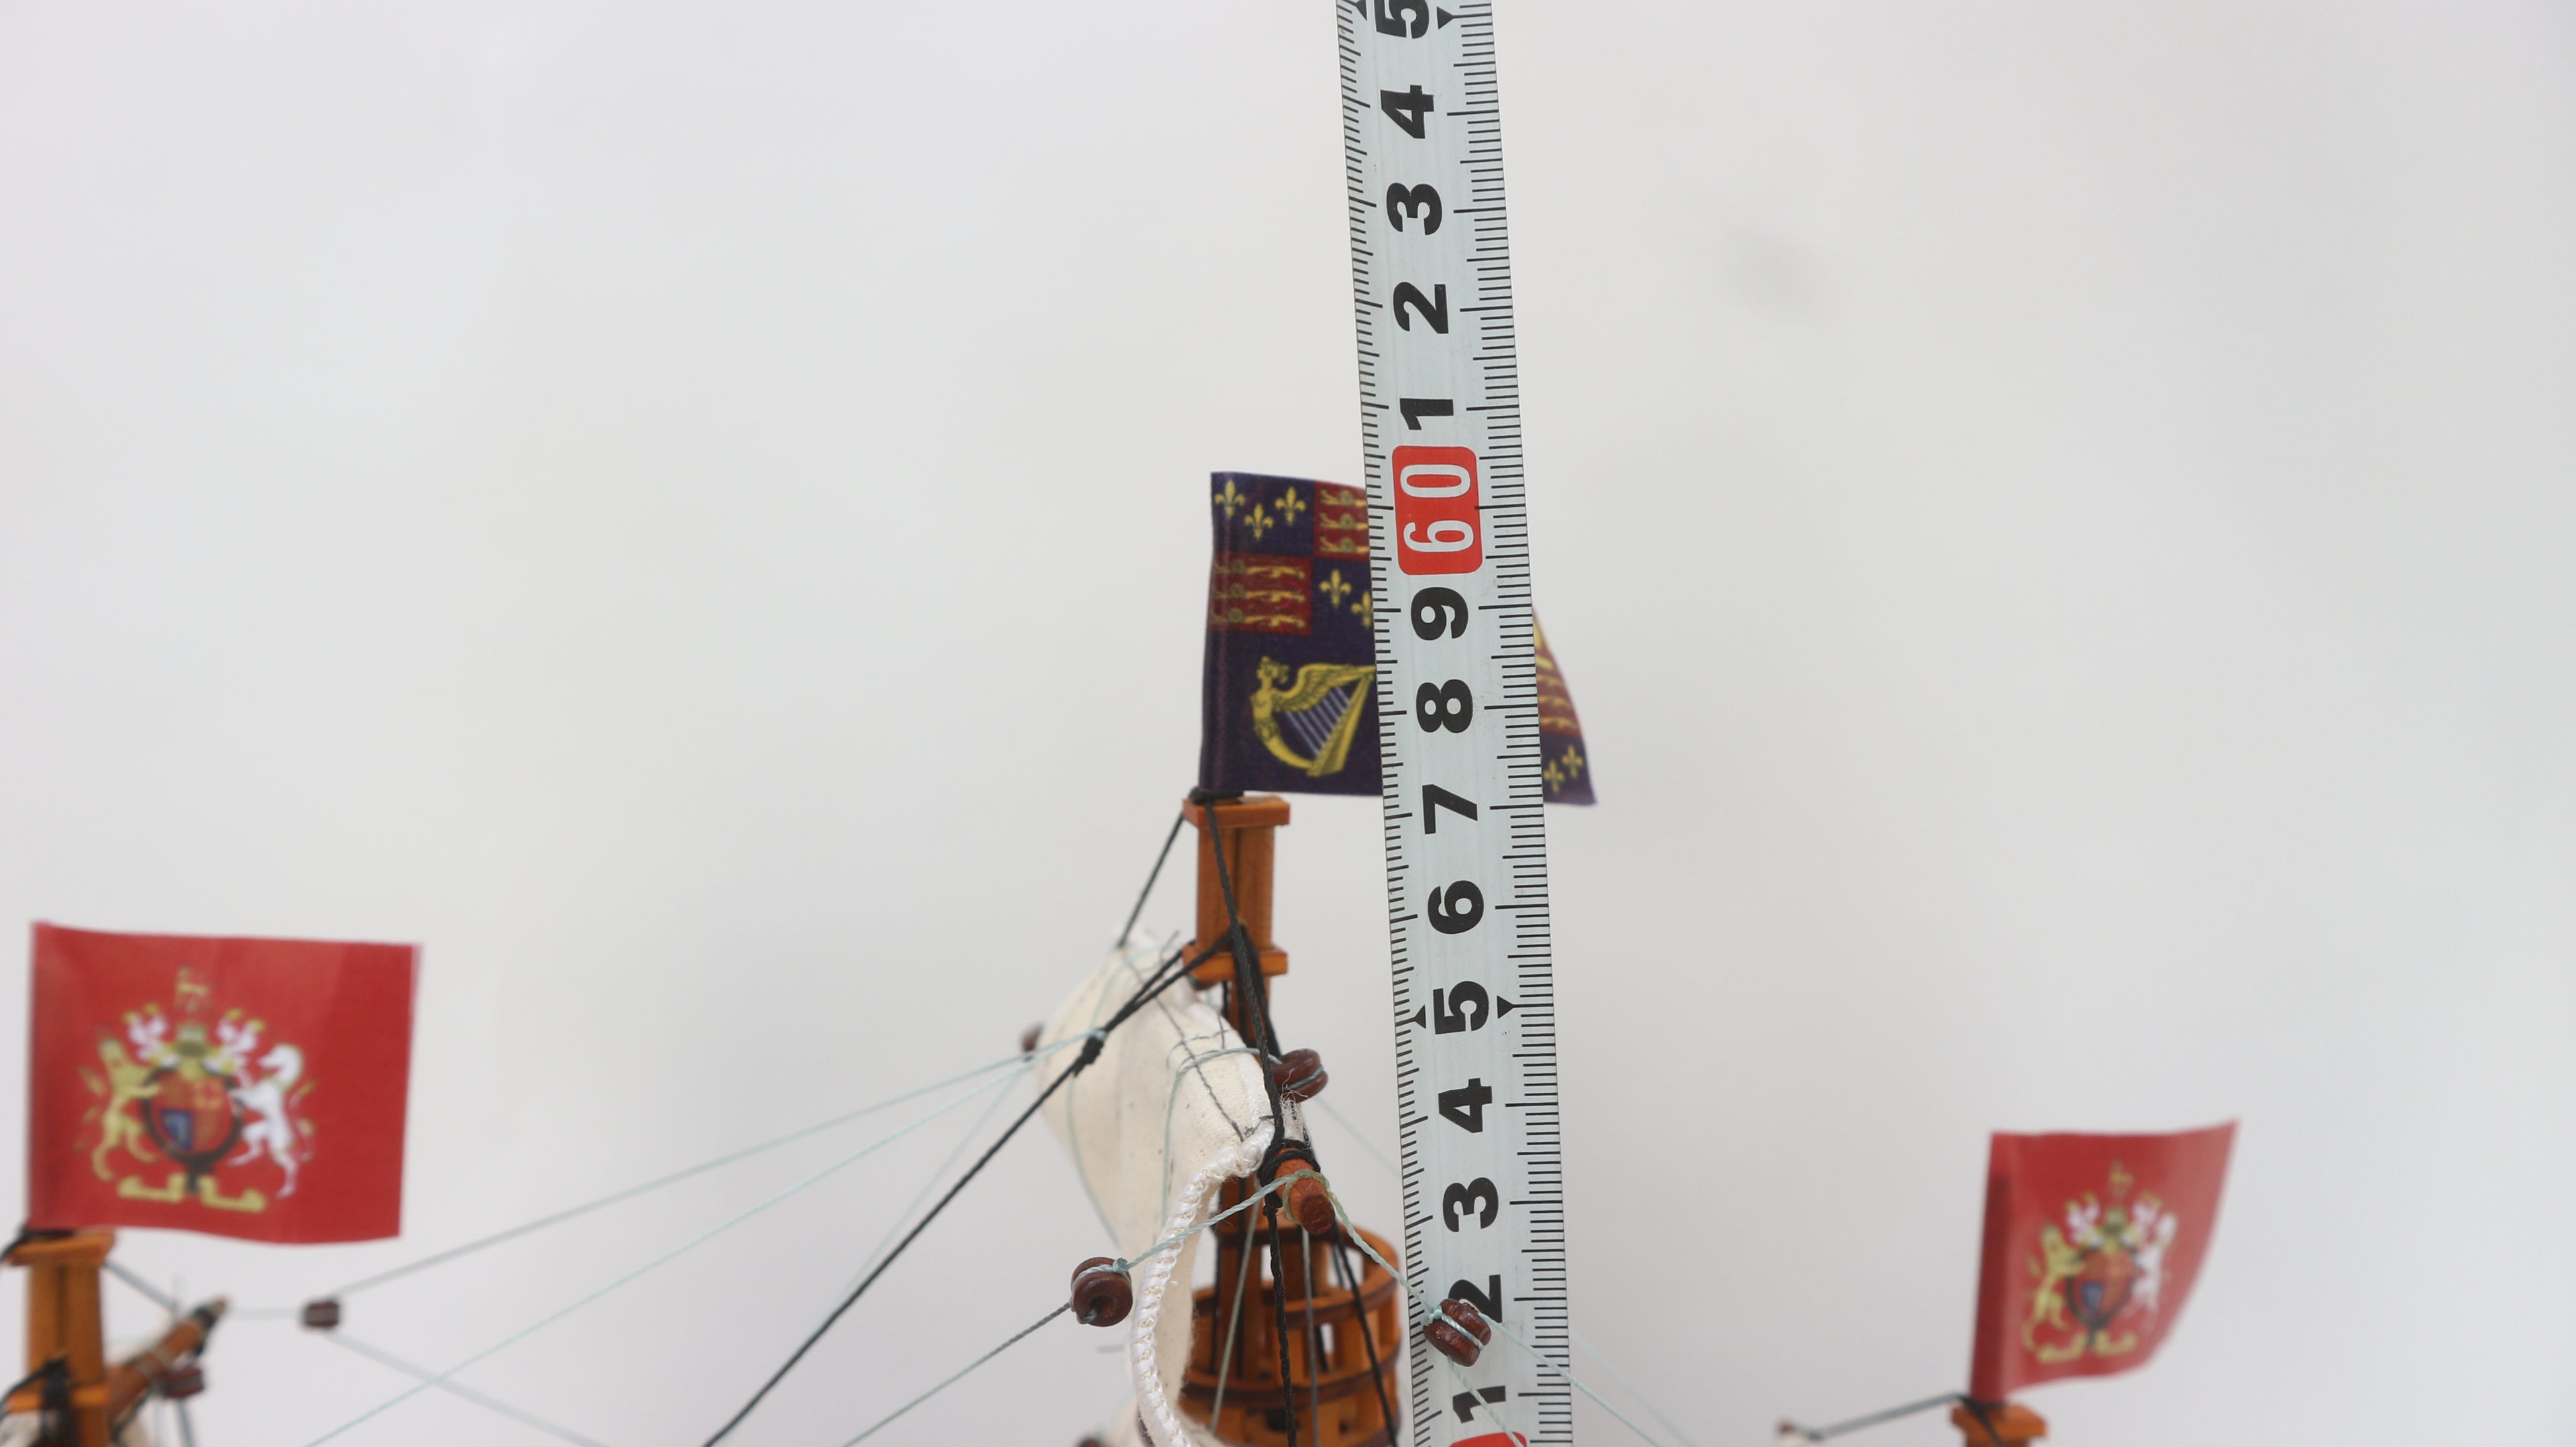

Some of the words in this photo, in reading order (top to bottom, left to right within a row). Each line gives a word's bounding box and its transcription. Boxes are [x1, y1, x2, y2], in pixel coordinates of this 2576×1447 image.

[1376, 0, 1430, 39] 5
[1380, 85, 1434, 139] 4
[1386, 182, 1442, 235] 3
[1393, 282, 1449, 334] 2
[1399, 398, 1454, 431] 1
[1400, 464, 1474, 553] 60
[1410, 586, 1468, 641] 9
[1415, 679, 1473, 734] 8
[1421, 784, 1478, 835] 7
[1428, 880, 1485, 934] 6
[1432, 981, 1489, 1035] 5
[1438, 1077, 1493, 1134] 4
[1442, 1177, 1499, 1232] 3
[1448, 1274, 1503, 1324] 2
[1452, 1385, 1506, 1424] 1
